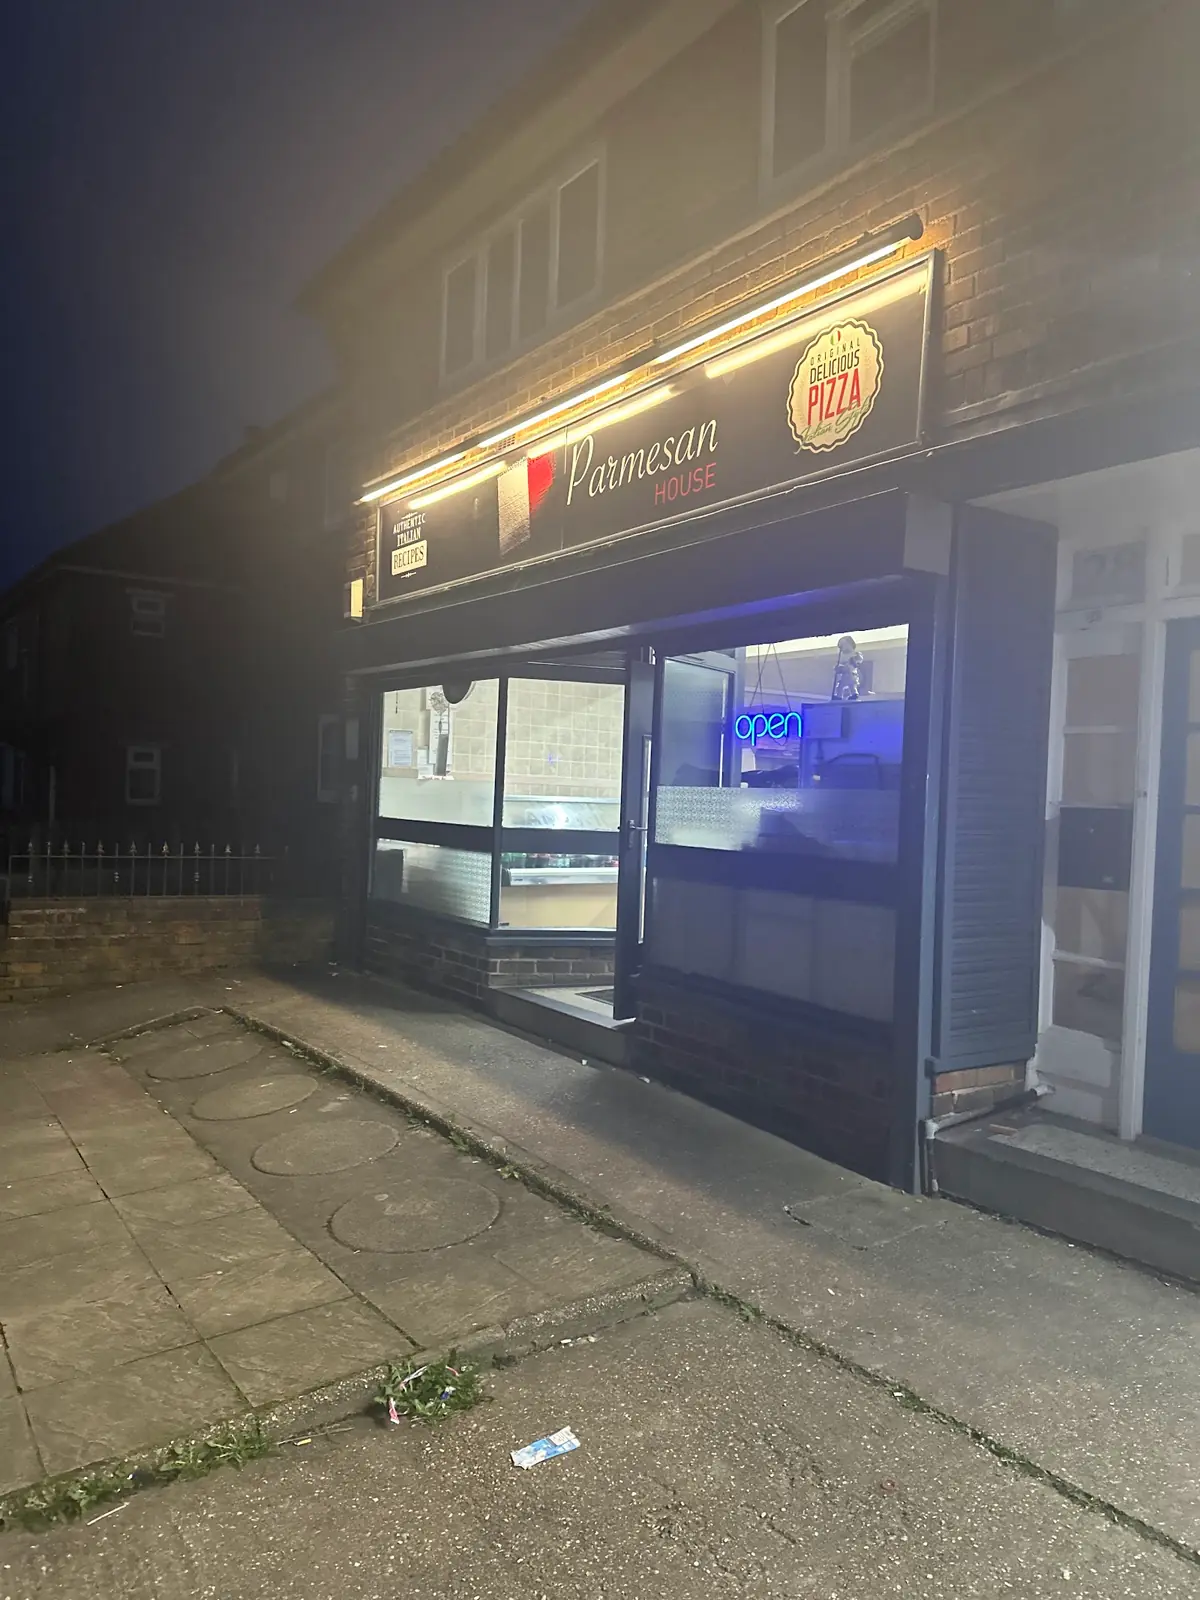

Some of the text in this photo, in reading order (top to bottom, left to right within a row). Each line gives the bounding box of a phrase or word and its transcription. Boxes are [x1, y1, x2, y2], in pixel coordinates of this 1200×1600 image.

[810, 337, 860, 366] ORIGINAL
[810, 349, 860, 384] DELICIOUS
[807, 368, 861, 426] PIZZA
[566, 419, 719, 506] Parmesan
[654, 462, 717, 505] HOUSE
[393, 513, 426, 534] AUTHENTIC
[397, 527, 421, 547] ITALIAN
[394, 546, 424, 569] RECIPES
[735, 711, 803, 747] open
